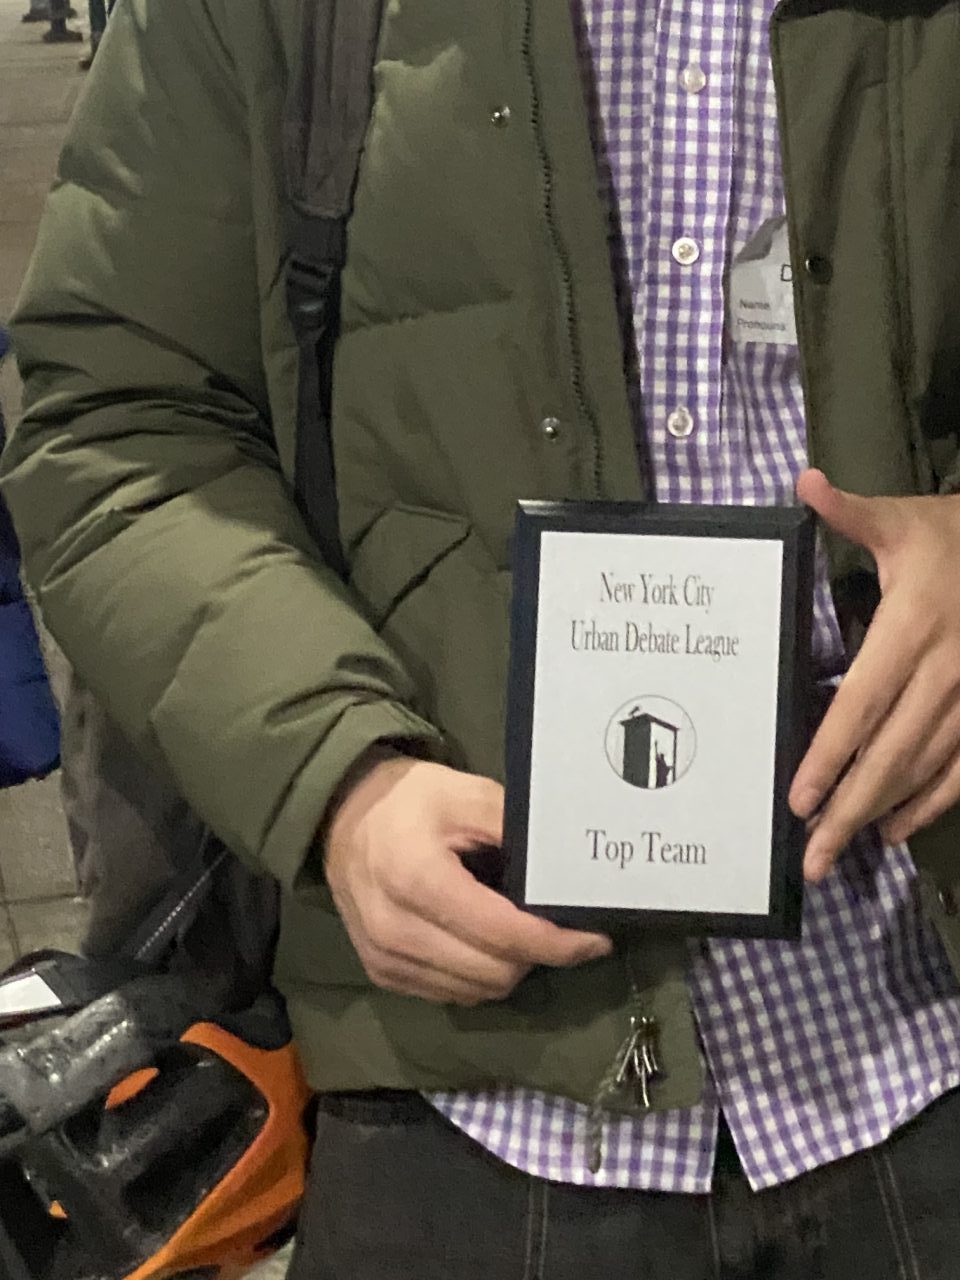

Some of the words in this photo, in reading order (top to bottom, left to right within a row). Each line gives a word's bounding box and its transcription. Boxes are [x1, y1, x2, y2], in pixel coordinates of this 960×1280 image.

[600, 571, 635, 604] New
[640, 573, 679, 606] York
[683, 573, 715, 614] City
[571, 619, 619, 652] Urban
[625, 621, 680, 655] Debate
[685, 623, 740, 663] League
[585, 828, 634, 870] Top
[641, 830, 707, 865] Team
